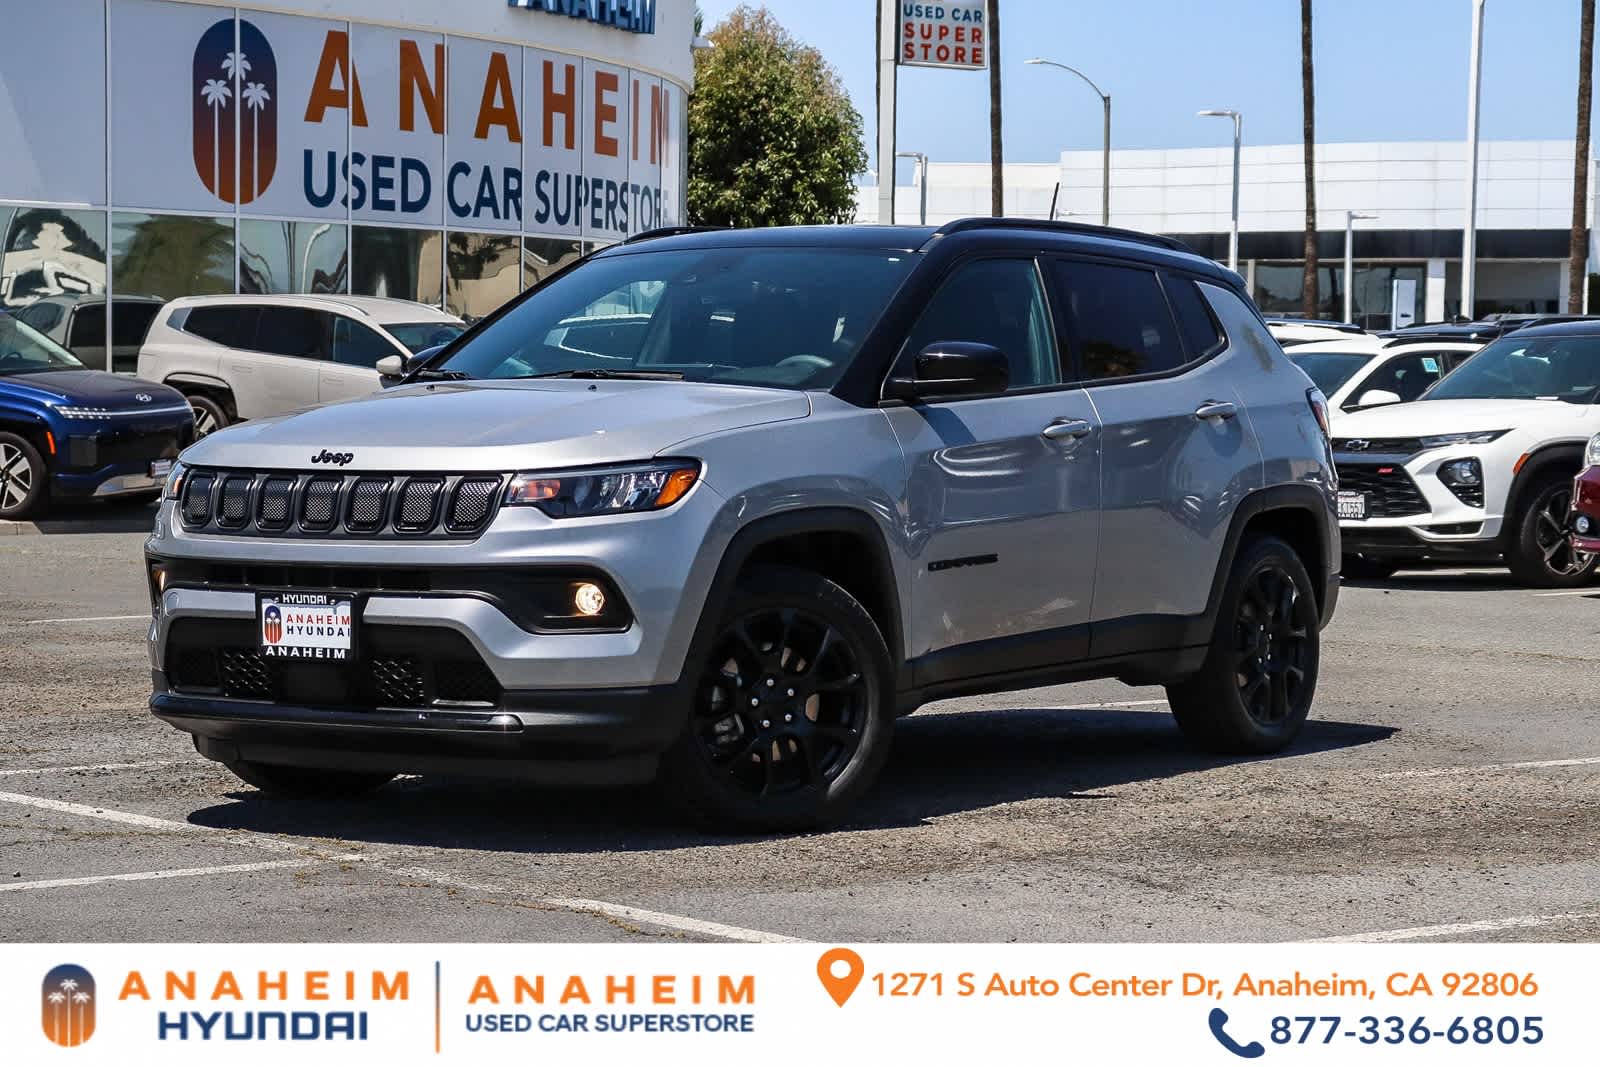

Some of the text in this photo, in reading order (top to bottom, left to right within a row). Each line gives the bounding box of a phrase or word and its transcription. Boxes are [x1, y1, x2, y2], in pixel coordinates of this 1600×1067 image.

[903, 4, 983, 22] USED CAR
[904, 21, 982, 43] SUPER
[904, 42, 982, 64] STORE
[304, 30, 669, 168] ANAHEIM
[303, 148, 432, 213] USED
[447, 161, 523, 222] CAR
[311, 448, 354, 467] Jeep
[282, 593, 328, 605] HYUNDAI
[286, 613, 352, 625] ANAHEIM
[286, 625, 351, 638] HYUNDAI
[265, 645, 346, 659] ANAHEIM
